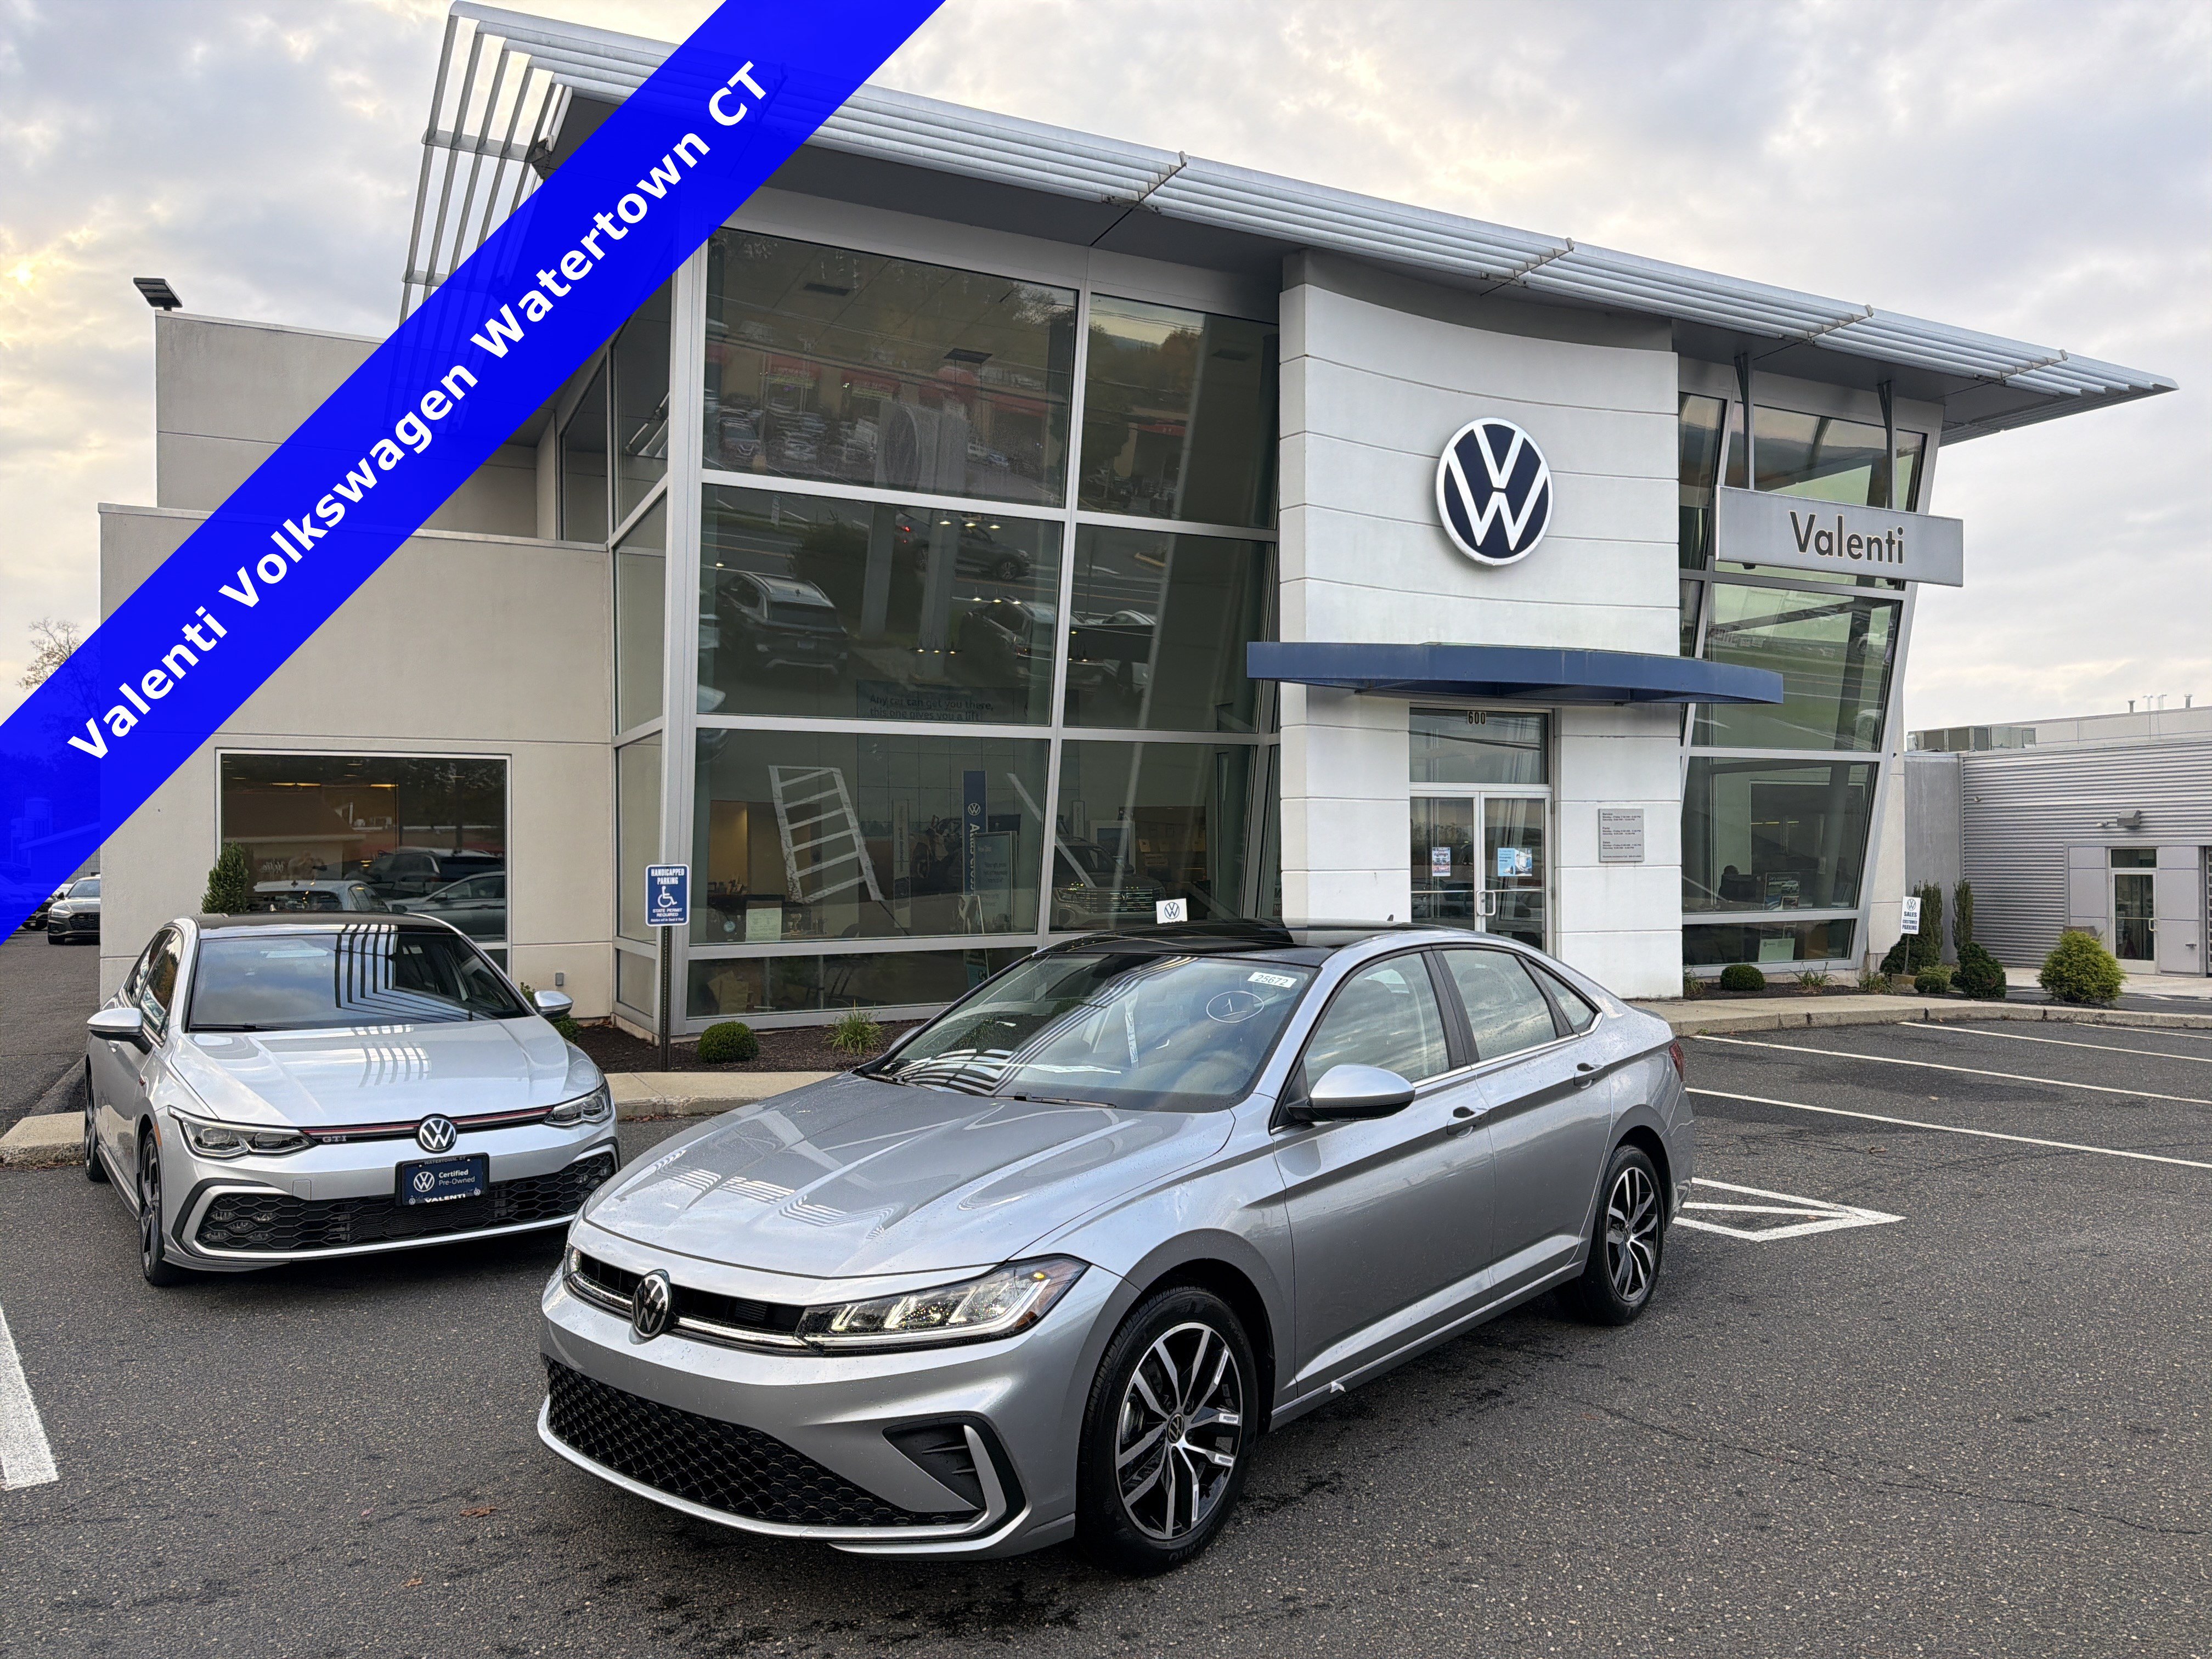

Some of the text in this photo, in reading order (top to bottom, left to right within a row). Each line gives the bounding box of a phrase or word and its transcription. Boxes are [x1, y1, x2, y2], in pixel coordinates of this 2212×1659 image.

[1790, 511, 1904, 565] Valenti
[906, 698, 923, 707] can
[1469, 712, 1486, 724] 600
[1255, 974, 1289, 986] 25672
[439, 1169, 469, 1178] Certified
[438, 1176, 476, 1186] Pre-Owned
[424, 1193, 466, 1203] VALENTI
